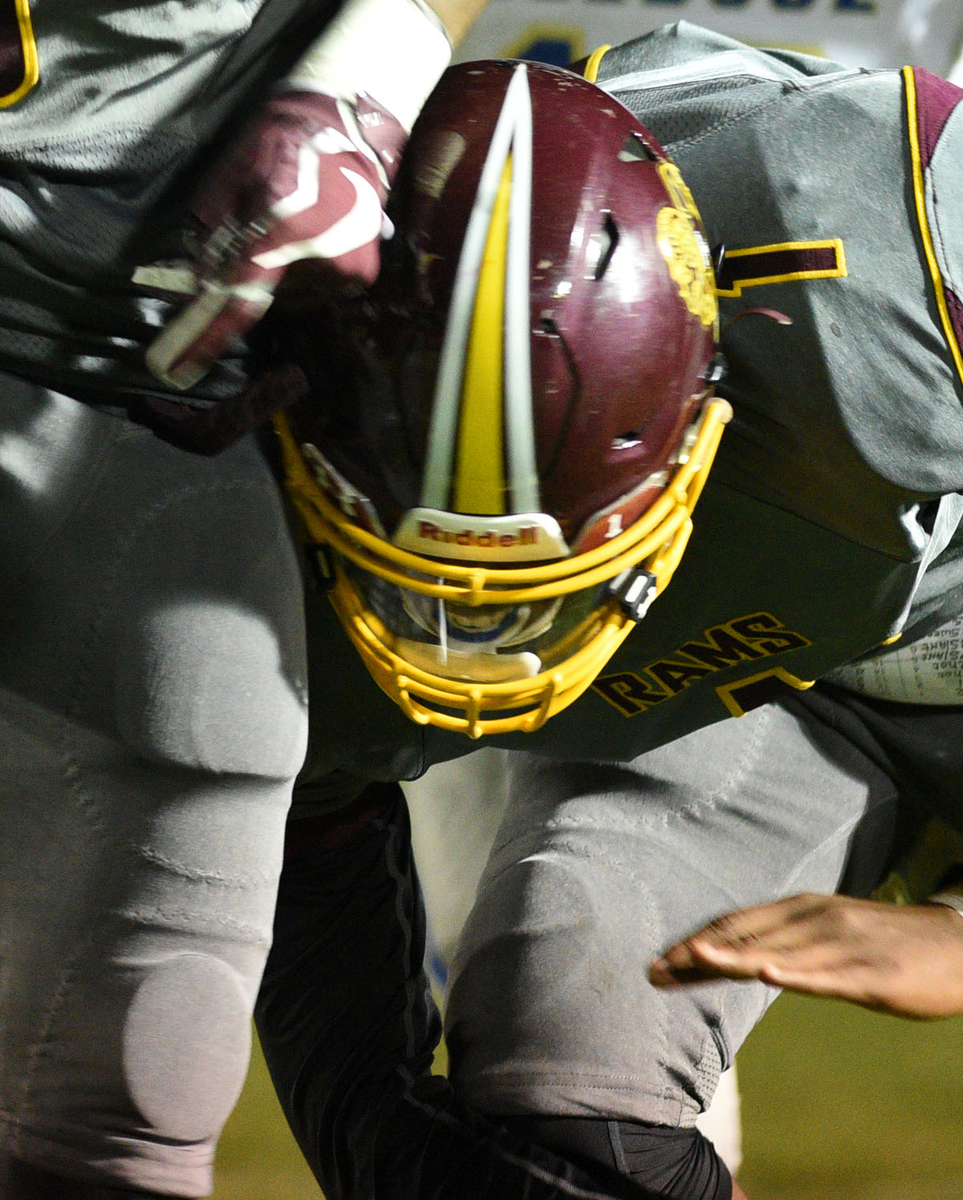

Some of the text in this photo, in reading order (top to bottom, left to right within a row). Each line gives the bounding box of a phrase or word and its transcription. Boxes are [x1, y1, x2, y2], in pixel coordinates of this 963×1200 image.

[417, 520, 539, 547] Riddell
[603, 513, 624, 539] 1
[590, 611, 813, 718] RAMS
